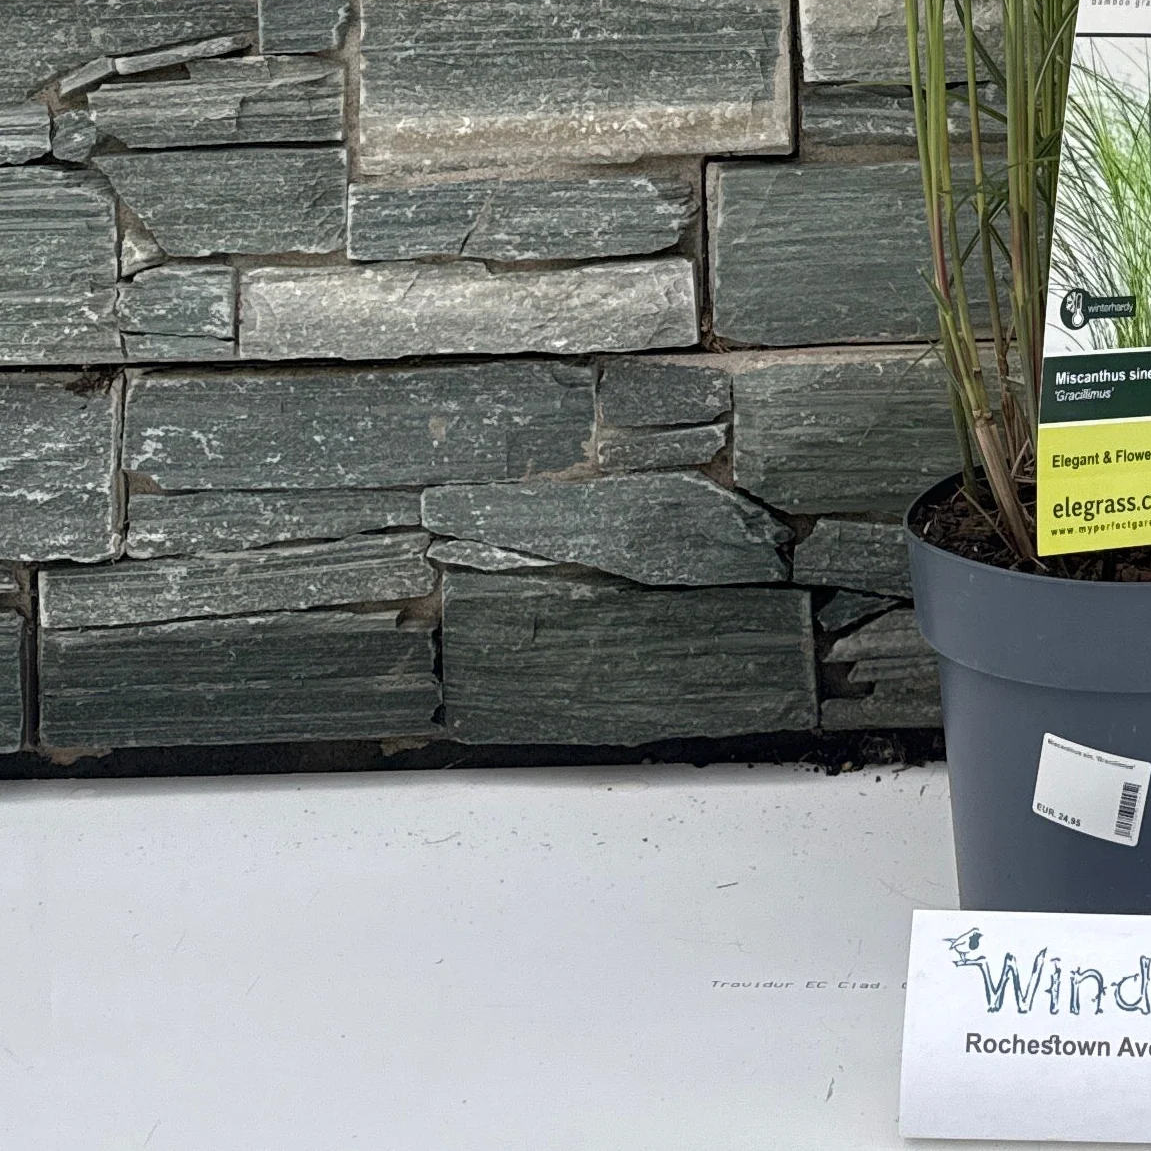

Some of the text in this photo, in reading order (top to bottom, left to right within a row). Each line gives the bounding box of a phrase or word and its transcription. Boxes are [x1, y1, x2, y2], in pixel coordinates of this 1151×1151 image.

[1055, 369, 1126, 385] Miscanthus
[1052, 452, 1100, 470] Elegant
[1102, 450, 1112, 464] &
[805, 980, 829, 989] EC
[965, 1032, 1111, 1057] Rochestown
